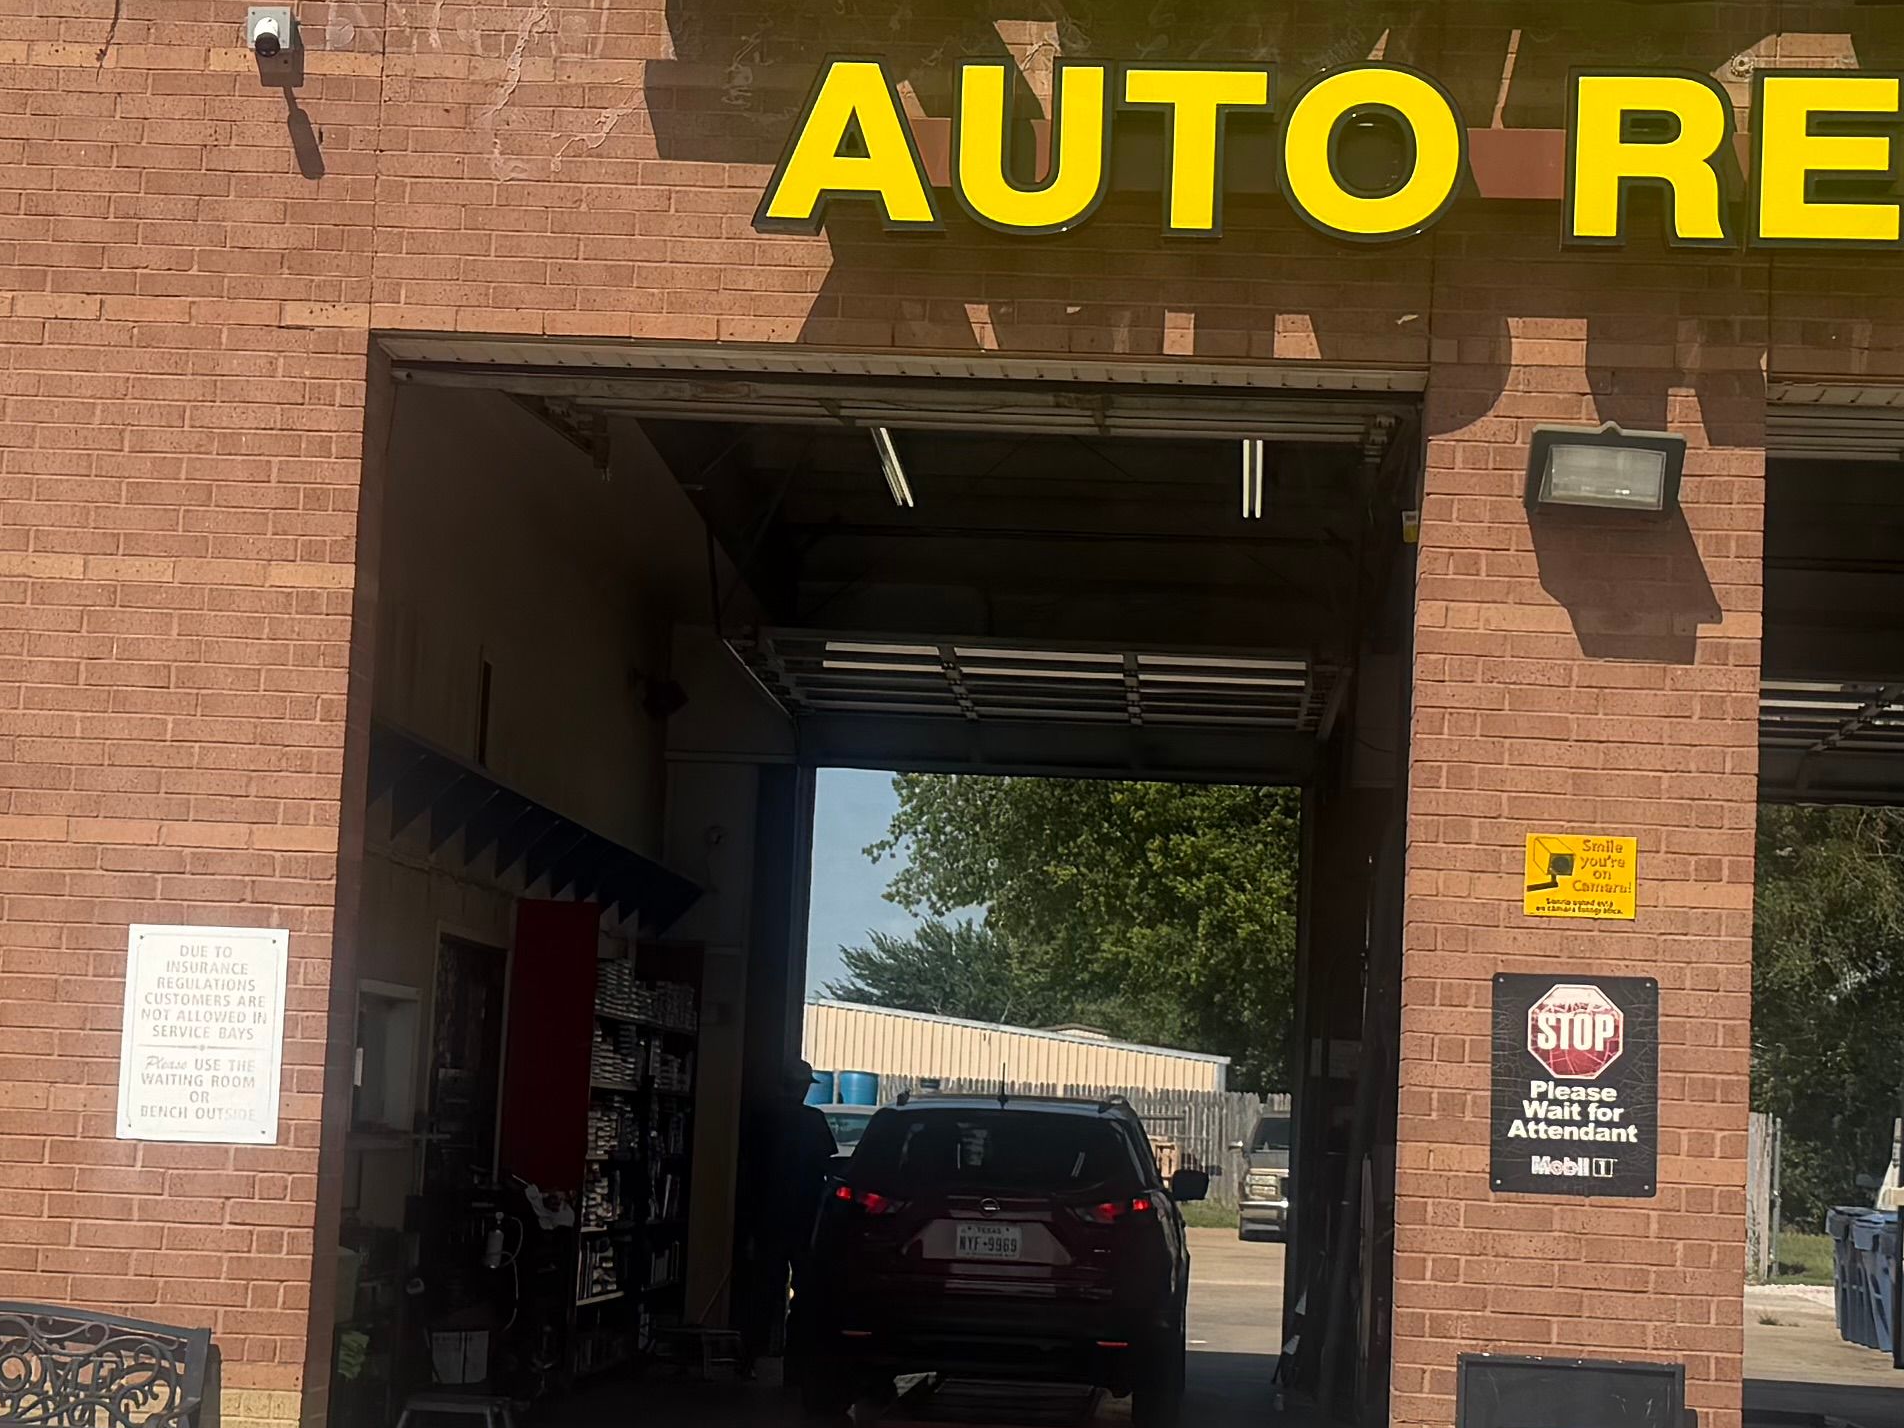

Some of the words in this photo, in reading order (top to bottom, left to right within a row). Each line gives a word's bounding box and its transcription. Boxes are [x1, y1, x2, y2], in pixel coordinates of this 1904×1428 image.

[758, 59, 1463, 240] AUTO
[1582, 838, 1624, 853] Smile
[1580, 855, 1625, 869] you're
[1593, 870, 1612, 880] on
[179, 945, 208, 958] DUE
[215, 946, 233, 958] TO
[166, 960, 249, 975] INSURANCE
[157, 976, 256, 992] REGULATIONS
[144, 992, 230, 1007] CUSTOMERS
[236, 995, 266, 1008] ARE
[141, 1008, 171, 1021] NOT
[176, 1009, 246, 1024] ALLOWED
[253, 1012, 267, 1025] IN
[152, 1024, 210, 1039] SERVICE
[218, 1026, 254, 1040] BAYS
[1537, 1013, 1615, 1051] STOP
[145, 1055, 187, 1070] Please
[194, 1058, 221, 1072] USE
[228, 1059, 256, 1072] THE
[141, 1073, 204, 1087] WAITING
[211, 1075, 255, 1088] ROOM
[189, 1090, 210, 1104] OR
[1530, 1080, 1617, 1101] Please
[140, 1105, 187, 1119] BENCH
[195, 1107, 257, 1121] OUTSIDE
[1522, 1100, 1581, 1120] Wait
[1588, 1103, 1625, 1122] for
[1508, 1120, 1639, 1143] Attendant
[1531, 1156, 1589, 1177] Mobil
